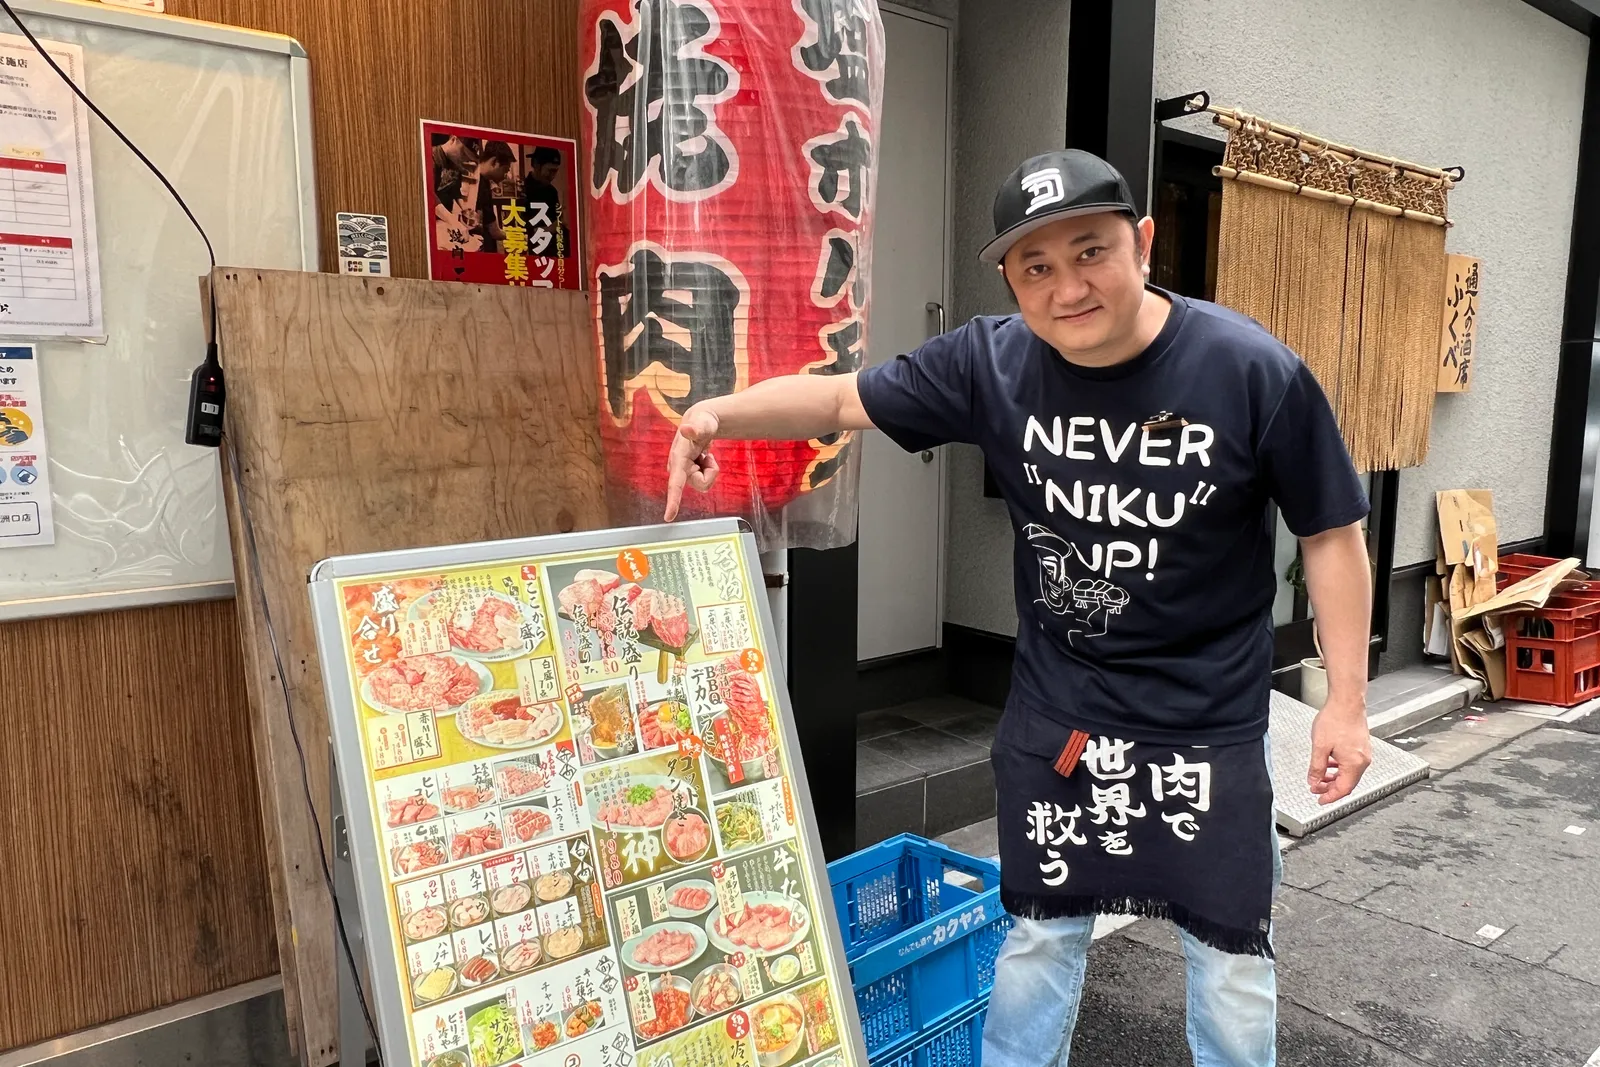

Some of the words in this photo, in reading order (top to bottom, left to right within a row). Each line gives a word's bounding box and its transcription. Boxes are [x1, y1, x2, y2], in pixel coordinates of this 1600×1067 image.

[584, 0, 741, 425] 焼肉
[1443, 274, 1464, 369] ふくべ
[1023, 415, 1215, 467] NEVER
[1071, 538, 1158, 581] UP!
[572, 604, 594, 664] 伝説盛り
[612, 595, 643, 681] 伝説盛り
[690, 668, 717, 748] デカハラミ
[703, 665, 722, 706] BBQ
[540, 761, 552, 788] カルビ
[1080, 736, 1147, 856] 世界を
[1148, 752, 1211, 842] 肉で
[484, 811, 498, 841] ハラミ
[552, 795, 565, 832] 上ハラミ
[622, 830, 661, 876] 神
[1026, 801, 1088, 886] 救う
[470, 868, 486, 913] 丸チョウ
[548, 852, 562, 887] ホルモン
[773, 846, 805, 928] 牛たん
[932, 905, 986, 945] カクヤス
[434, 941, 450, 973] ハチノス
[584, 967, 596, 998] キムチ
[489, 1018, 508, 1062] サラダ
